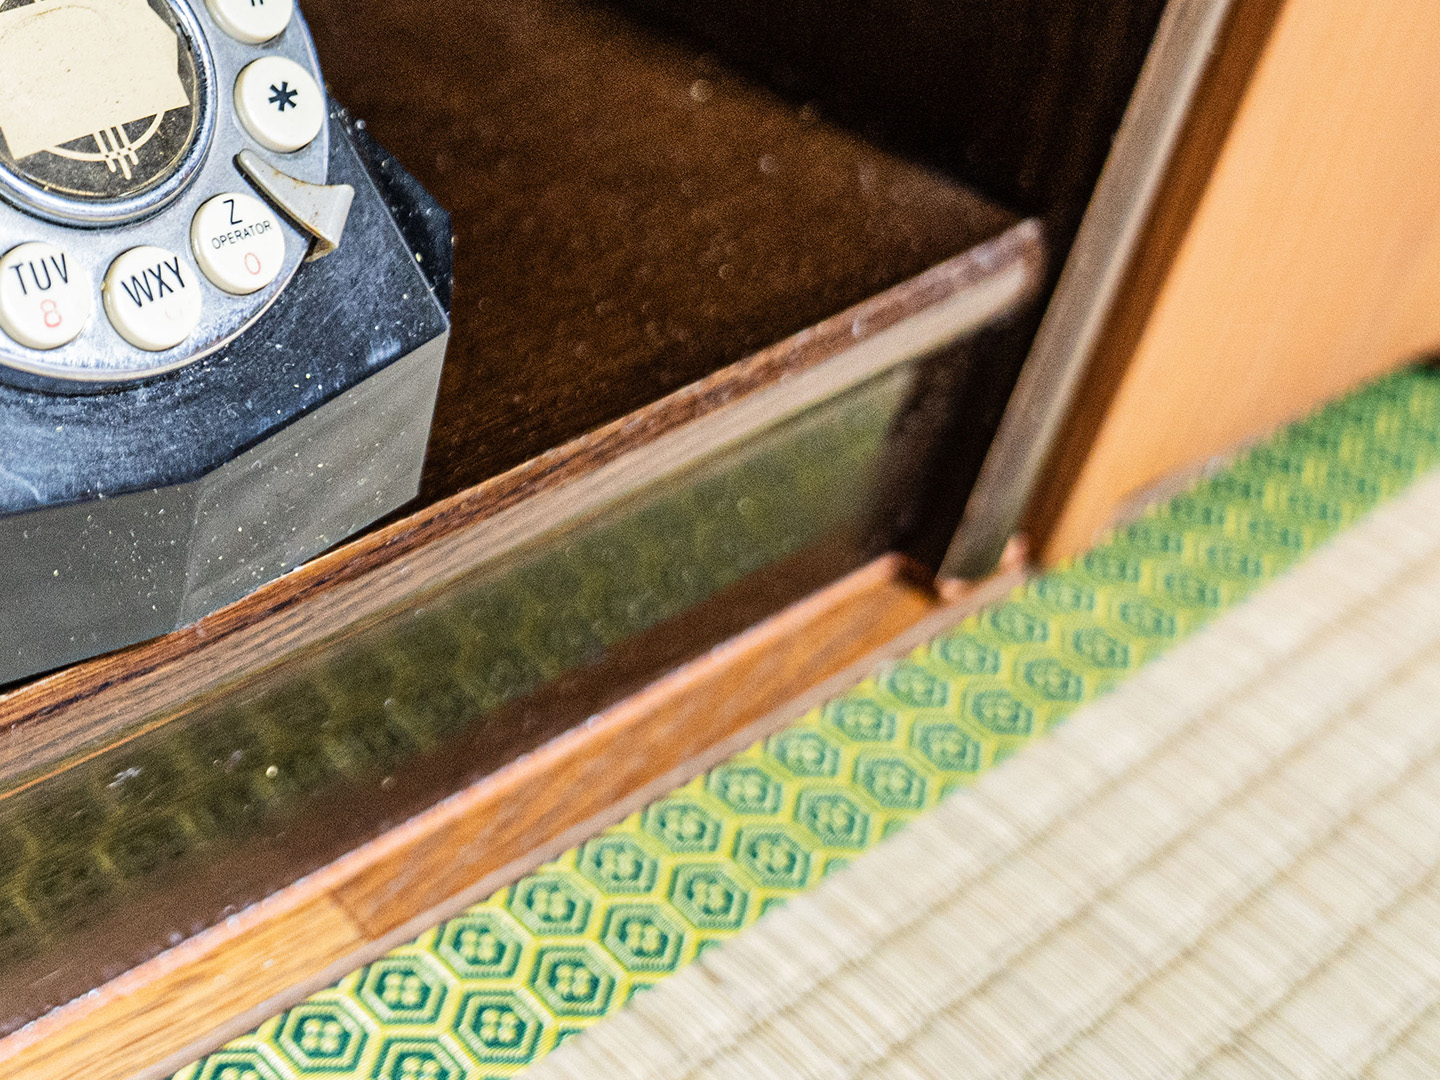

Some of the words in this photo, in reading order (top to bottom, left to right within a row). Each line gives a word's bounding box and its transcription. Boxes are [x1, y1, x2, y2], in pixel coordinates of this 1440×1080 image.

[223, 198, 243, 225] Z
[211, 220, 273, 250] OPERATOR
[10, 253, 69, 296] TUV
[244, 252, 261, 275] 0
[121, 256, 185, 307] WXY
[40, 299, 62, 328] 8
